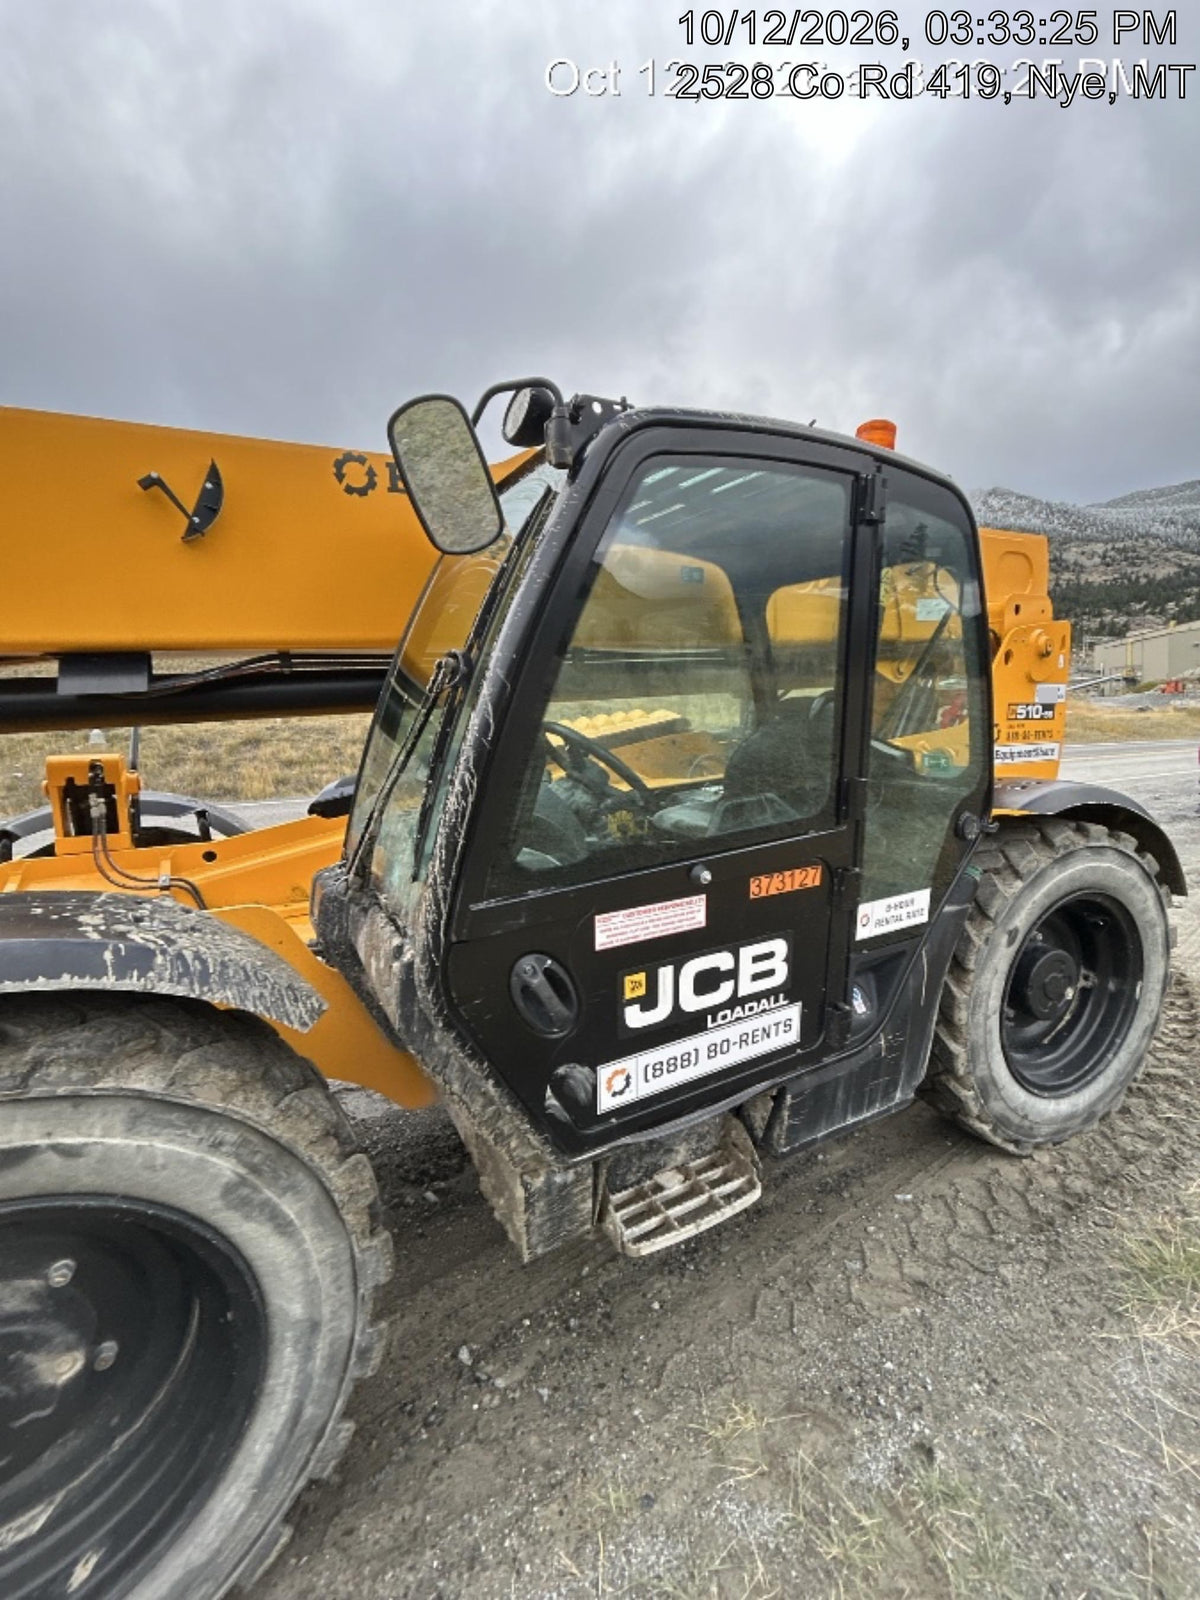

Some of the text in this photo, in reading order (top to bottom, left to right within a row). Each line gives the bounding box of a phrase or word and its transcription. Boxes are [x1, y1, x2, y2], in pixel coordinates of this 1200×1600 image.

[751, 867, 819, 896] 373127
[624, 938, 788, 1028] JCB
[707, 993, 790, 1029] LOADALL
[643, 1018, 793, 1084] (888) 80-RENTS
